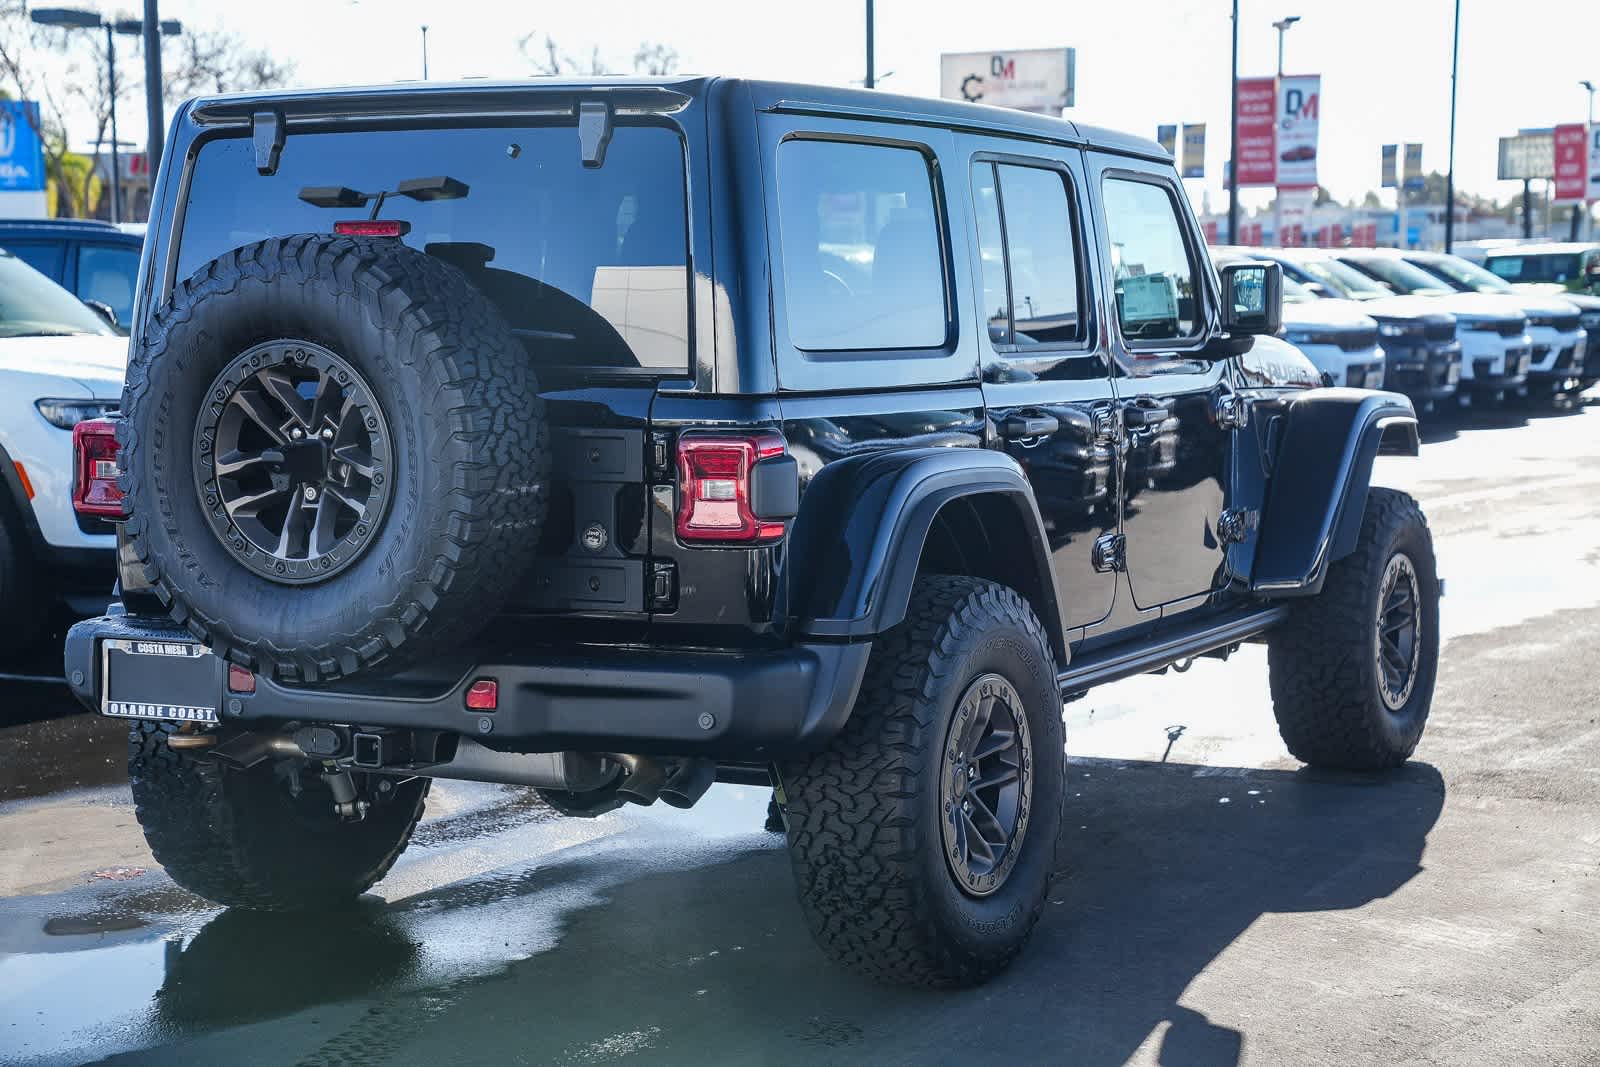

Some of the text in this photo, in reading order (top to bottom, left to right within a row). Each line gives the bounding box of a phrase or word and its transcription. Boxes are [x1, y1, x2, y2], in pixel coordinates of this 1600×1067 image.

[137, 643, 187, 655] COSTA MESA
[110, 703, 212, 720] ORANGE COAST
